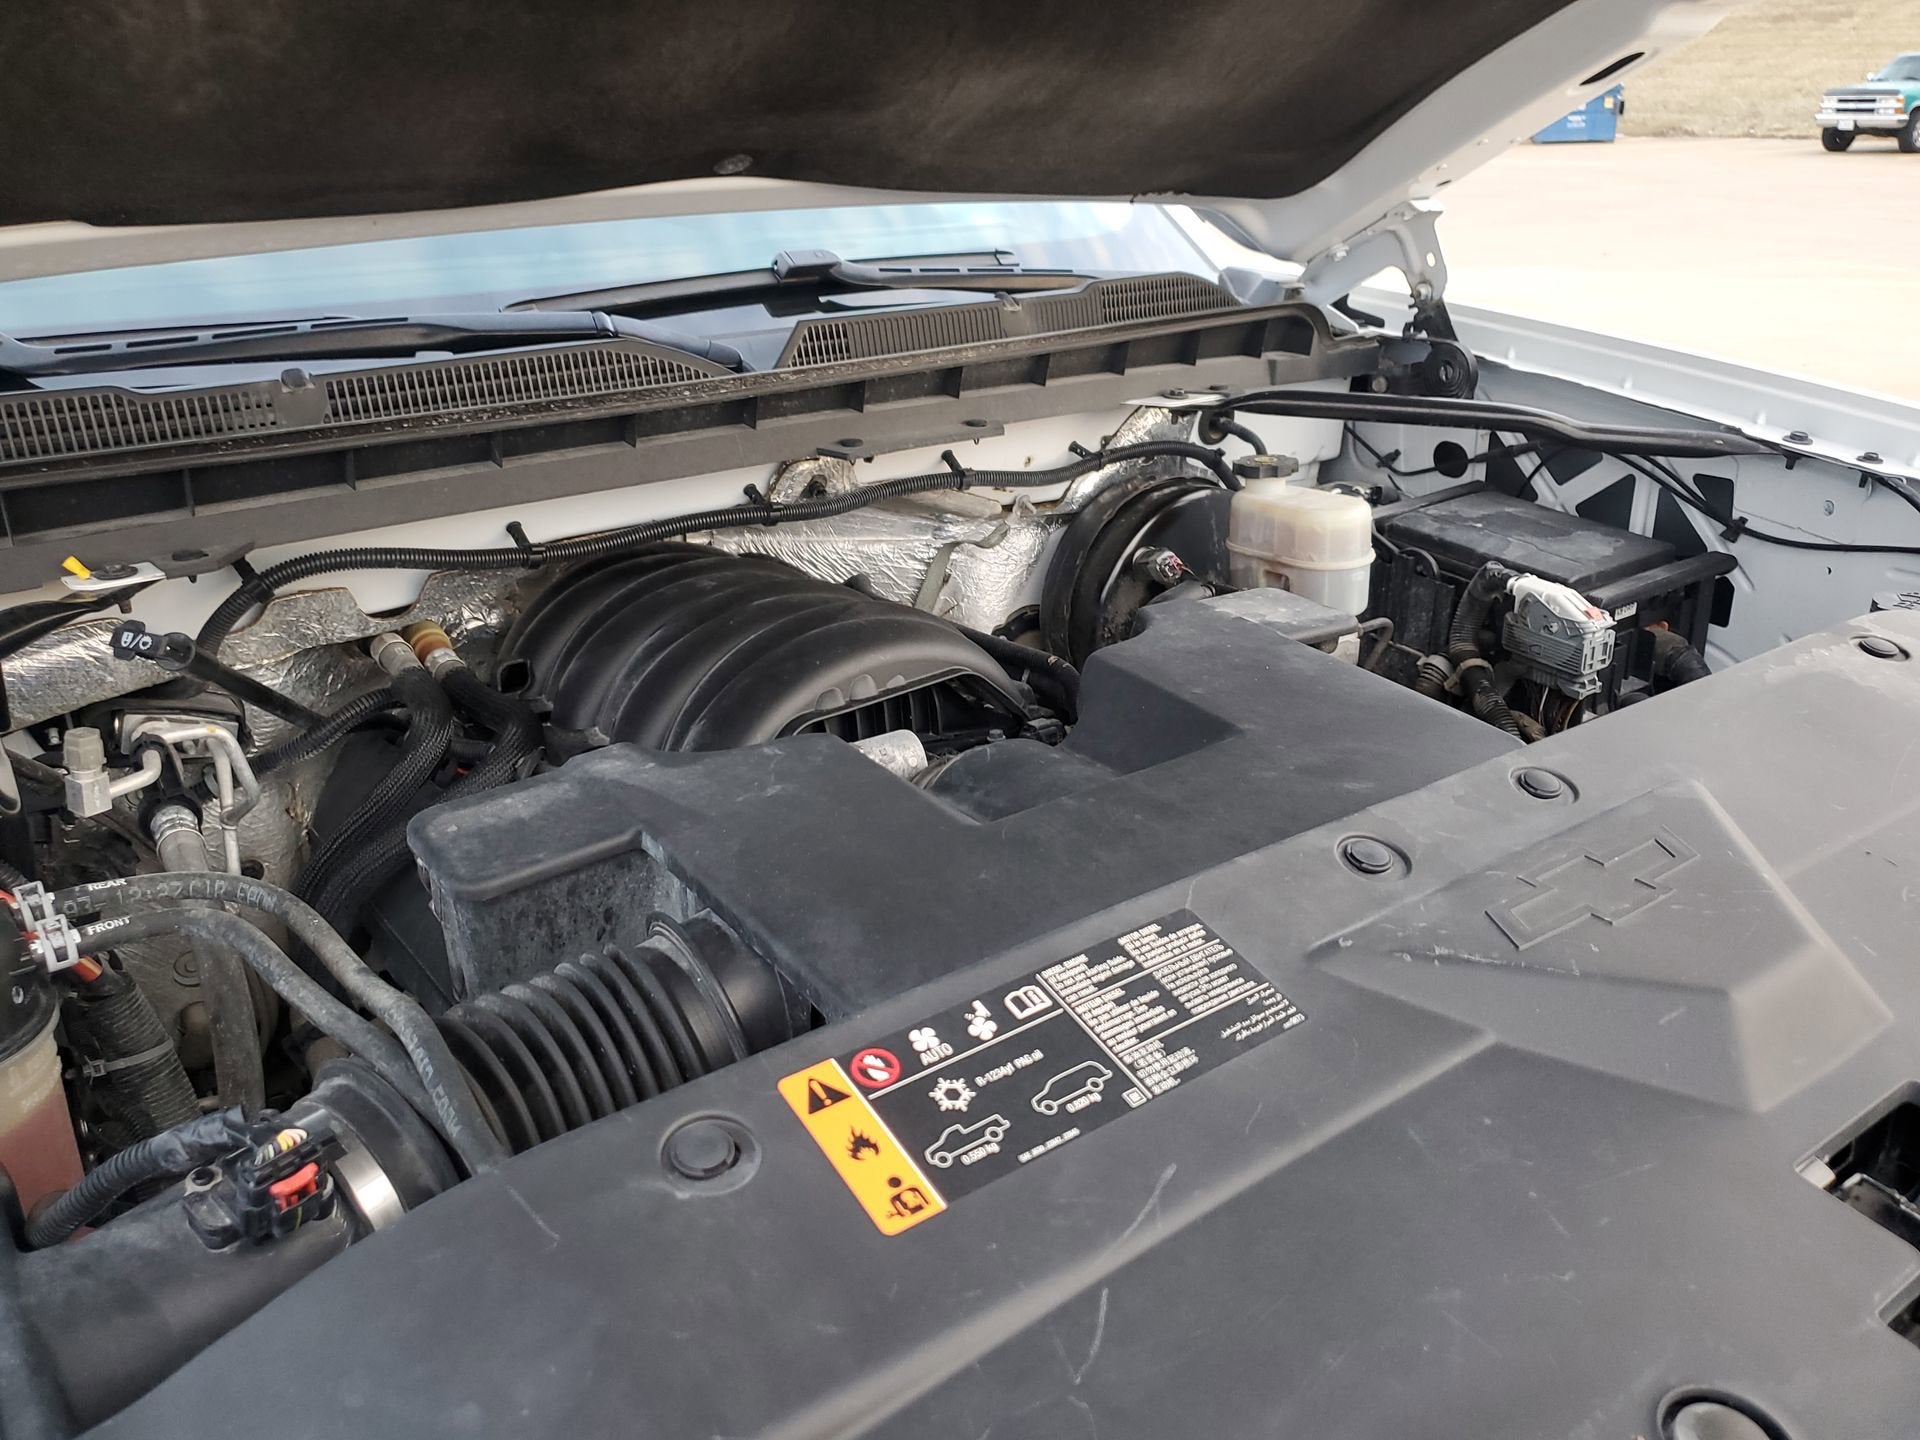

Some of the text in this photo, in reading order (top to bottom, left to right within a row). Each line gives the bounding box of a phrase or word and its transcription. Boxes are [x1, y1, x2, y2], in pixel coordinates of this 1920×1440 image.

[87, 878, 128, 891] REAR
[87, 915, 131, 936] FRONT
[1117, 923, 1160, 944] MOTOR DIESEL
[1041, 954, 1087, 977] DIESEL ENGINE
[1111, 960, 1135, 973] damage
[1075, 988, 1125, 1013] MOTEUR DIESEL
[920, 1044, 952, 1064] AUTO
[976, 1050, 1042, 1087] R-1234yf PAG oil
[1090, 1092, 1101, 1102] kg
[986, 1142, 999, 1153] kg
